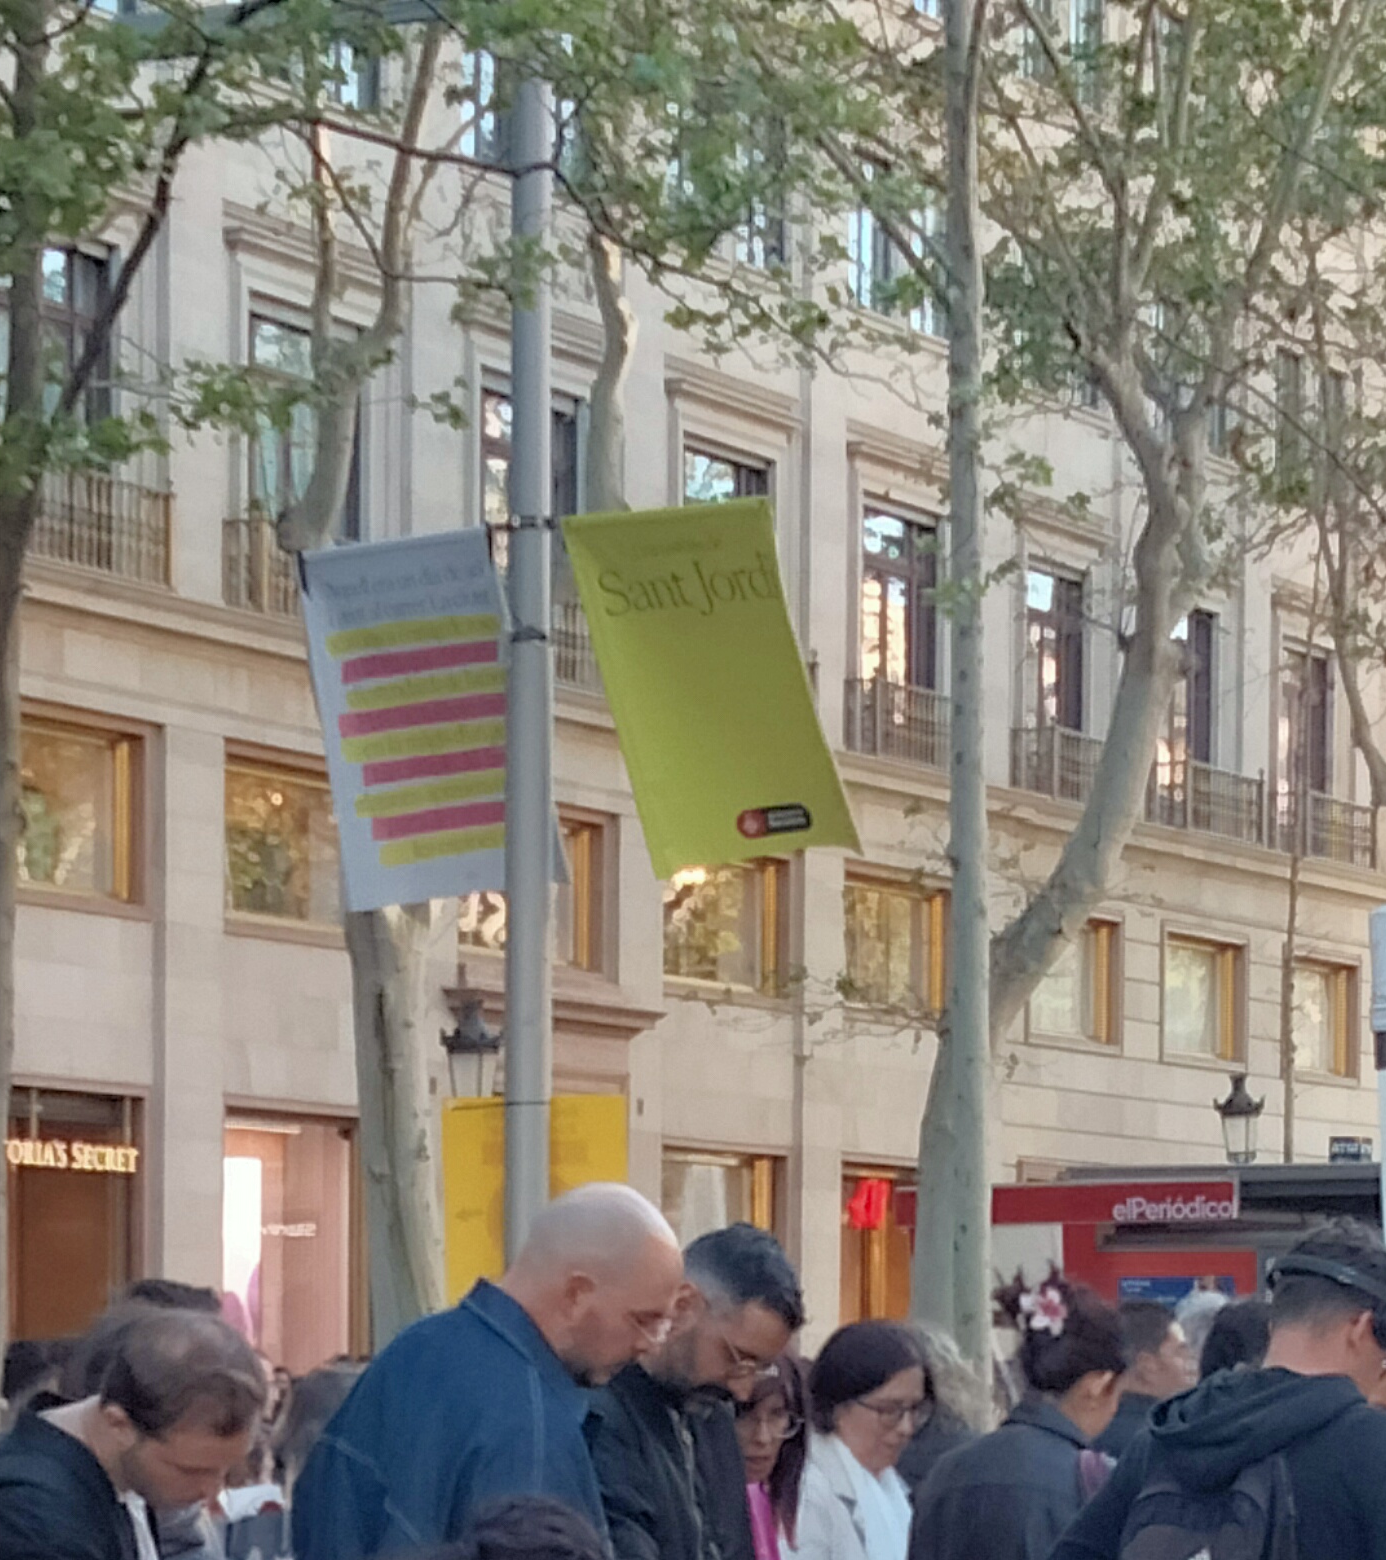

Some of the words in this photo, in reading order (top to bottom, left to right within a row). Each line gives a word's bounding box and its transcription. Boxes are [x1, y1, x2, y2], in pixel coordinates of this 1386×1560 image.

[597, 570, 692, 617] Sant
[3, 1139, 68, 1168] ORIA'S
[71, 1141, 140, 1173] SECRET
[1112, 1194, 1233, 1221] elPeriódico
